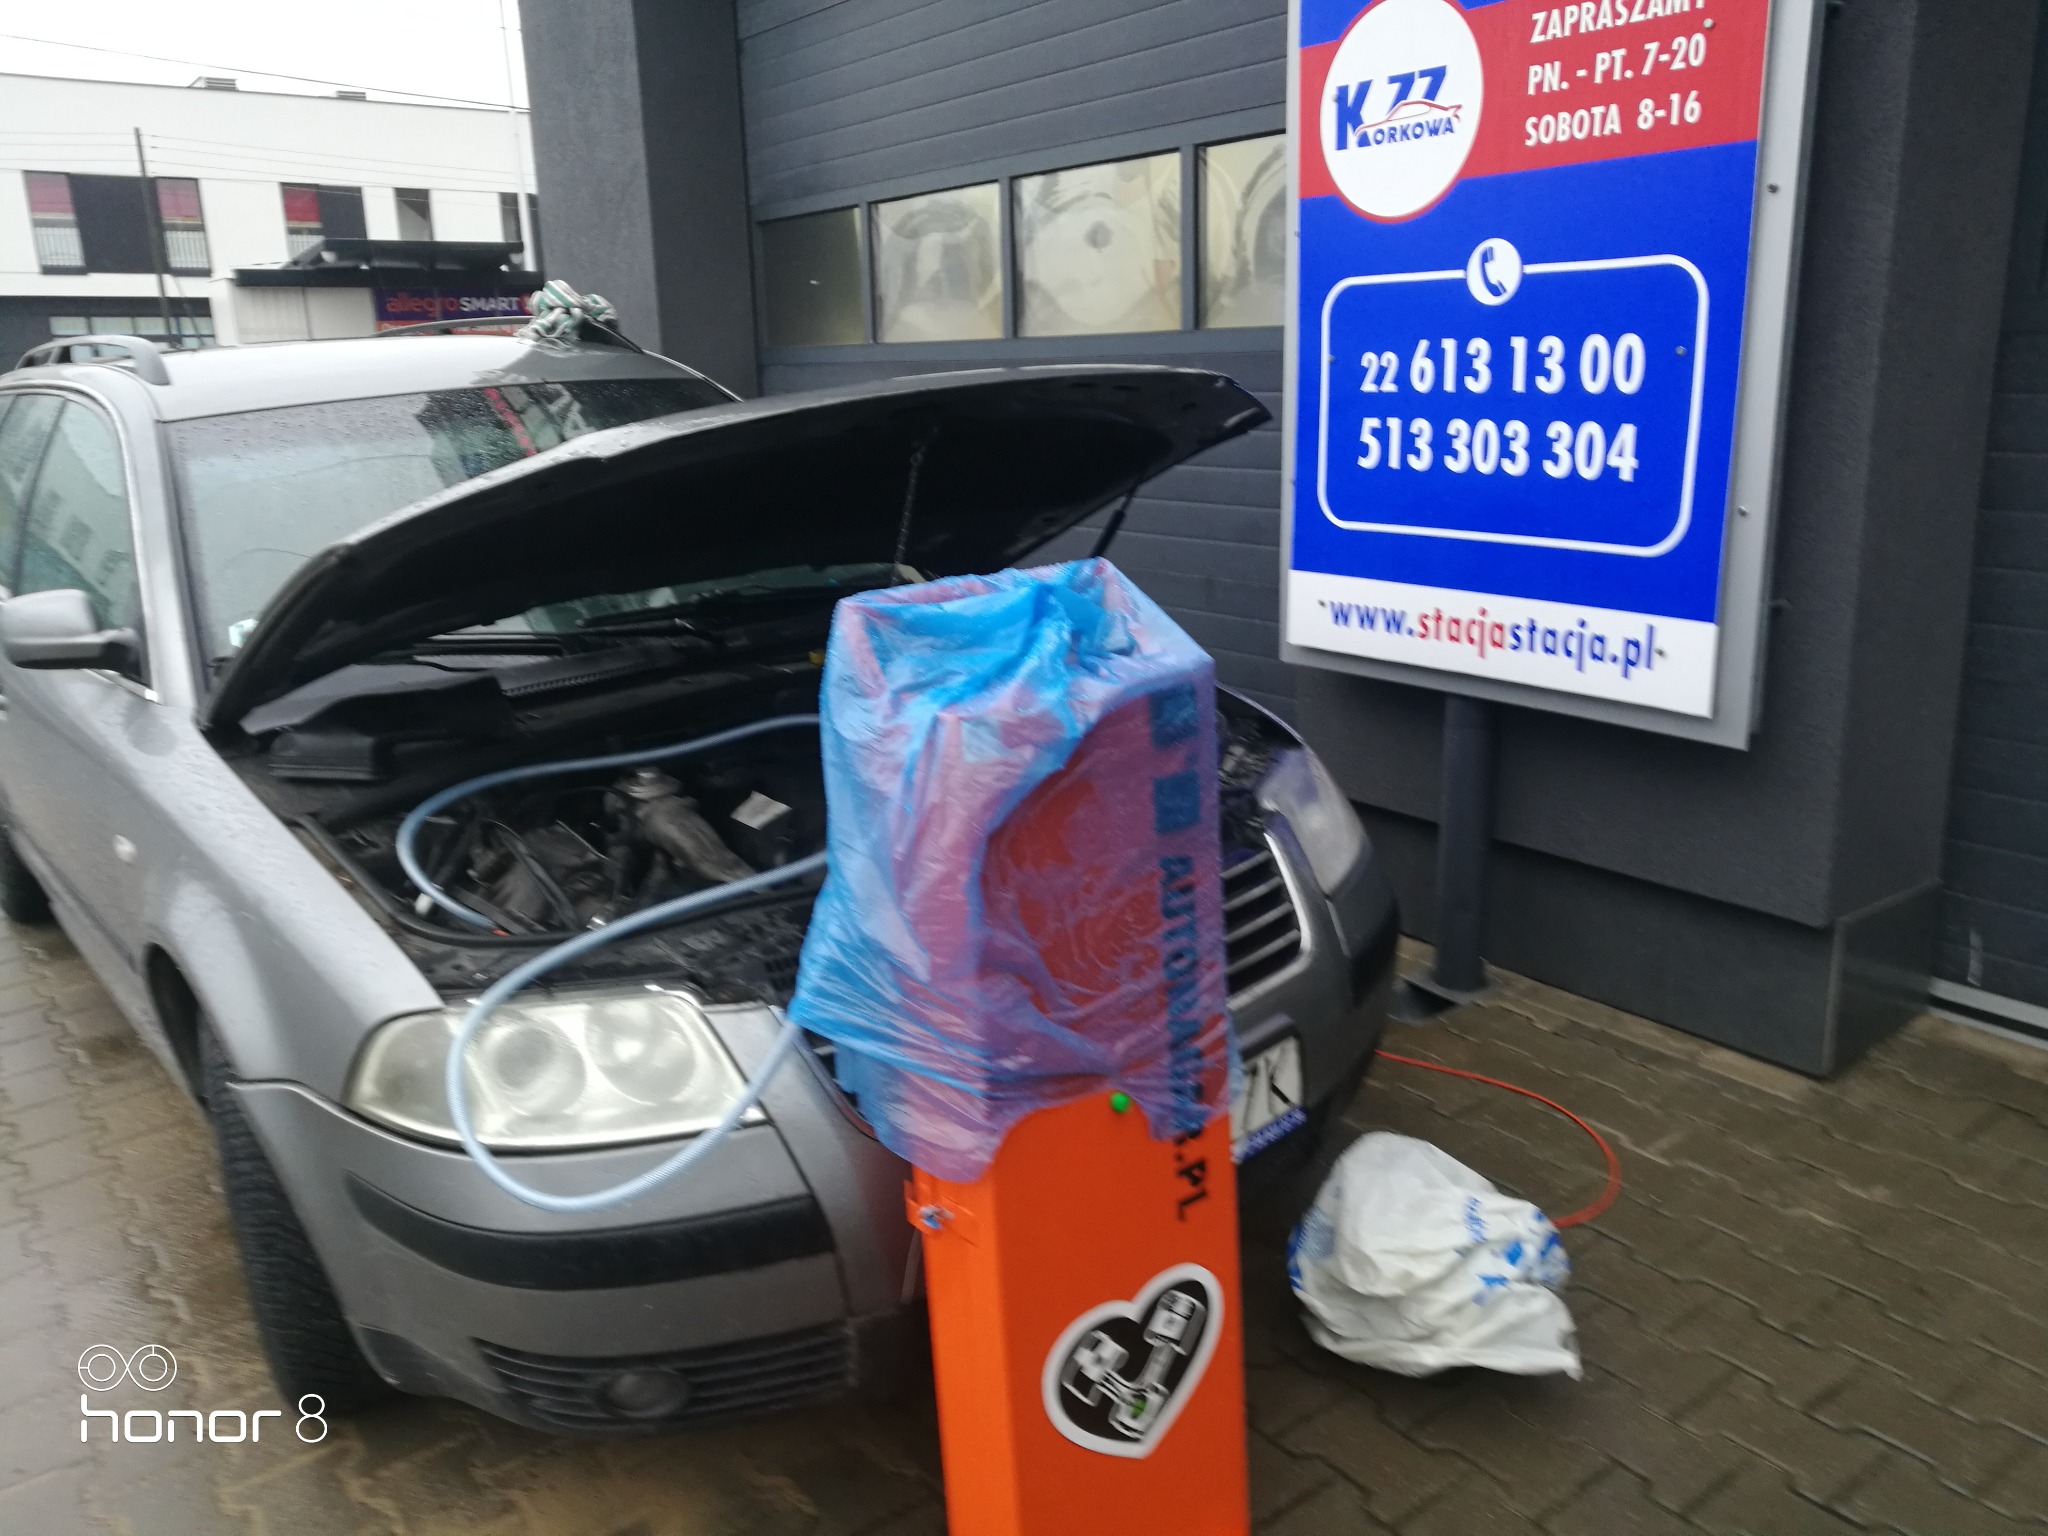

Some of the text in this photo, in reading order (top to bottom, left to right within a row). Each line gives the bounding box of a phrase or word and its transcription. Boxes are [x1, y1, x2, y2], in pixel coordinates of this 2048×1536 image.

[1529, 0, 1706, 43] ZAPRASZAM
[1527, 61, 1569, 95] PN.
[1593, 48, 1635, 84] PT.
[1641, 32, 1707, 76] 7-20
[1524, 90, 1702, 147] SOBOTA 8-16
[1360, 332, 1647, 395] 22 613 13 00
[1357, 417, 1639, 483] 513 303 304
[1329, 598, 1658, 680] www.stacjastacja.pl
